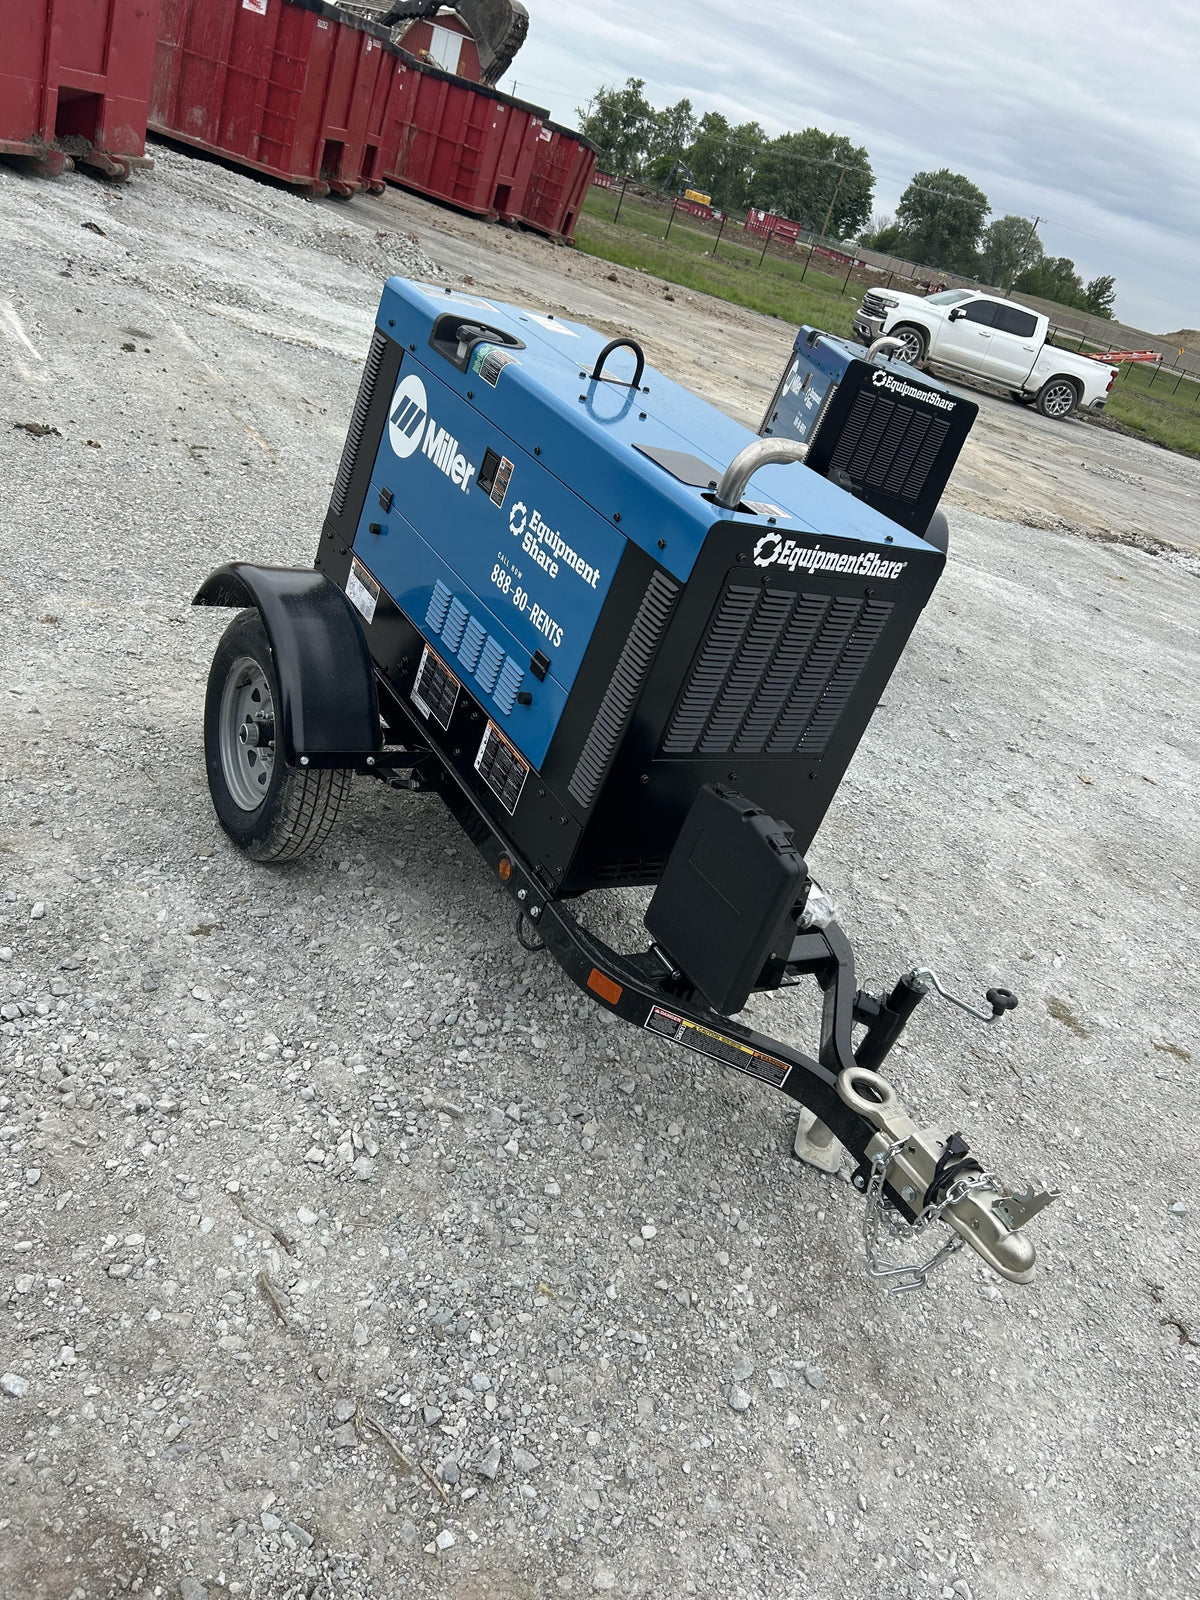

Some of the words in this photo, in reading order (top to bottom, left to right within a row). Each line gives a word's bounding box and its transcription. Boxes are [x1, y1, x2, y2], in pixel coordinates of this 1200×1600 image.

[884, 375, 955, 411] EquipmentShare
[421, 418, 476, 492] Miller
[497, 551, 510, 567] CALL
[510, 564, 523, 579] NOW
[521, 531, 559, 579] Share
[528, 509, 601, 590] Equipment
[776, 539, 904, 580] EquipmentShare
[490, 563, 564, 648] 888-80-RENTS
